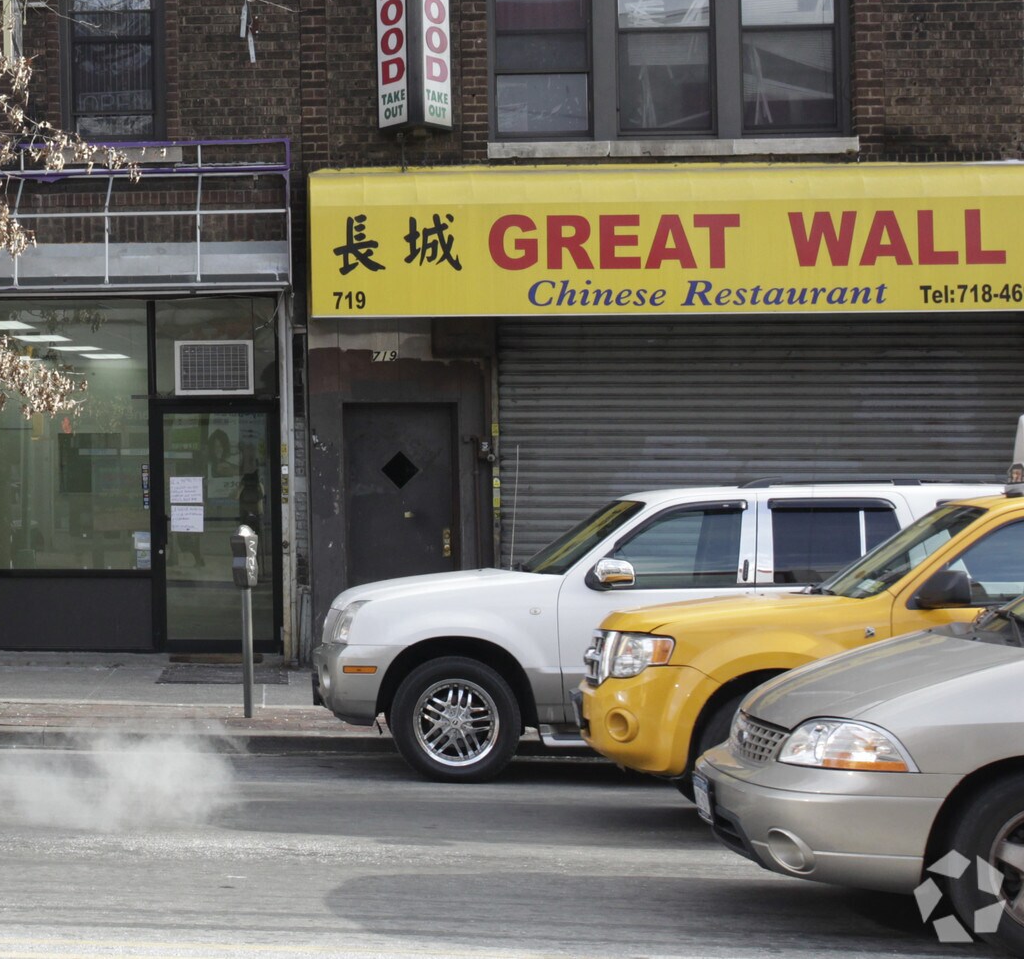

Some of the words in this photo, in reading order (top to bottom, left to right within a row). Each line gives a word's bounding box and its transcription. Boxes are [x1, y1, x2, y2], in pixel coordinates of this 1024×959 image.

[381, 89, 405, 105] TAKE
[426, 89, 448, 105] TAKE
[384, 104, 403, 119] OUT
[429, 104, 446, 119] OUT
[333, 213, 462, 275] 長城
[488, 214, 740, 270] GREAT
[788, 209, 1006, 266] WALL
[333, 291, 365, 309] 719
[528, 280, 666, 306] Chinese
[680, 280, 887, 306] Restaurant
[372, 351, 397, 361] 719
